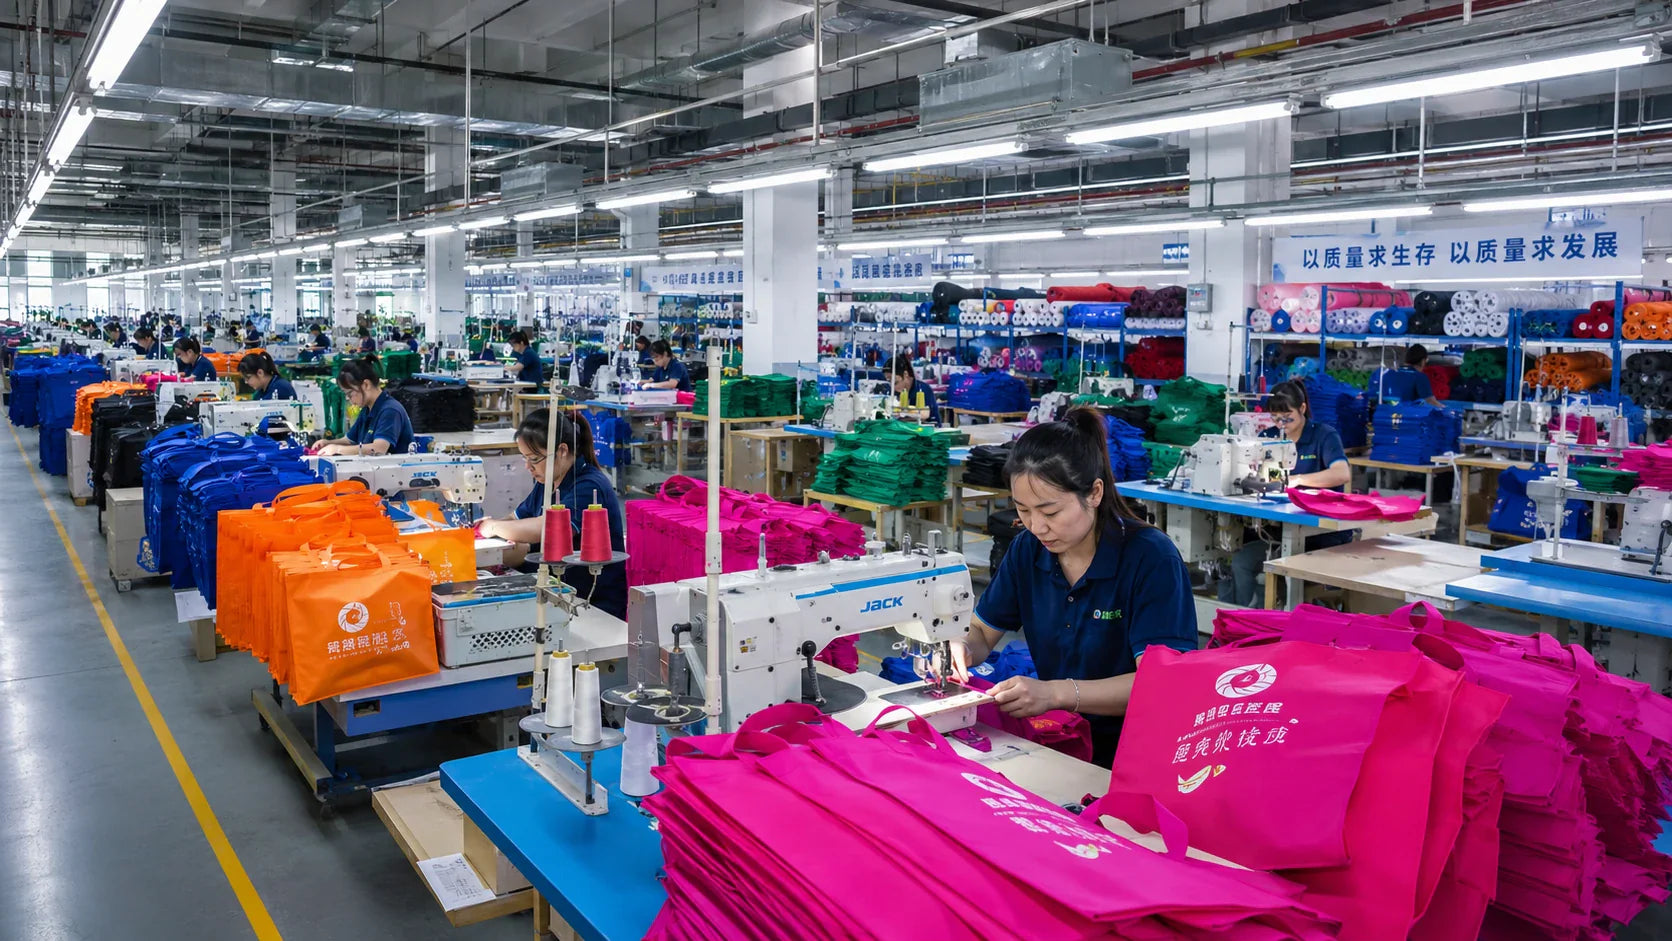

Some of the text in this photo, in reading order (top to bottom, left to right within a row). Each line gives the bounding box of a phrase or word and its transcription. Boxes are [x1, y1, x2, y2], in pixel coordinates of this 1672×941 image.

[1302, 231, 1619, 269] 以质量求生存 以质量求发展
[860, 595, 904, 613] JACK
